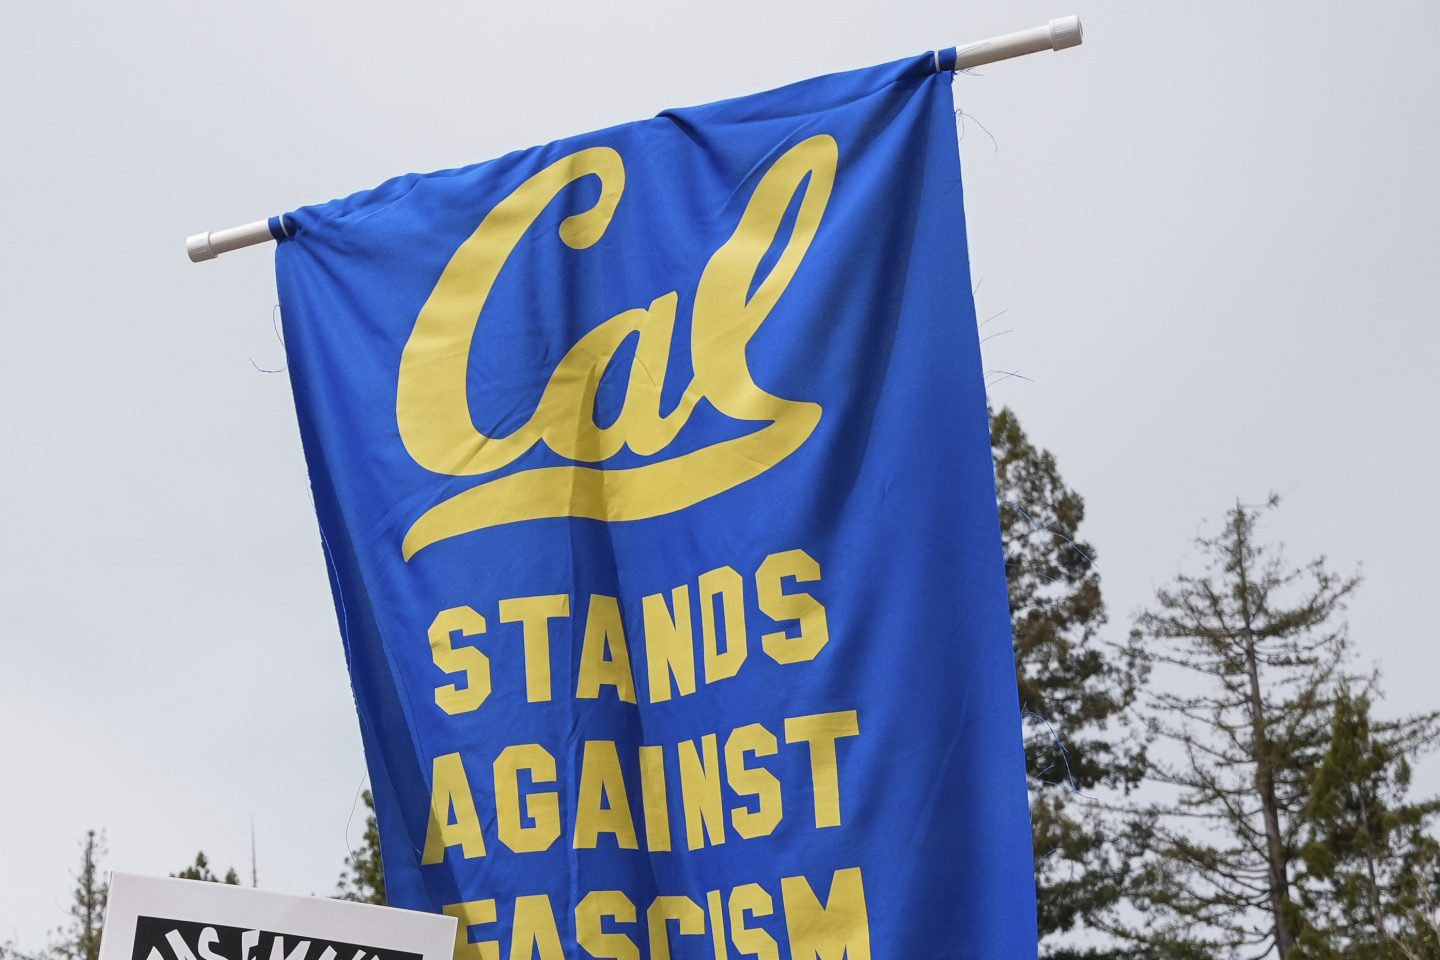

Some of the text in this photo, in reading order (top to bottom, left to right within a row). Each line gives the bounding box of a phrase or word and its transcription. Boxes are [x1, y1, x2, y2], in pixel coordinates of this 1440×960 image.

[397, 133, 839, 562] Cal
[427, 548, 830, 715] STANDS
[421, 710, 860, 865] AGAINST
